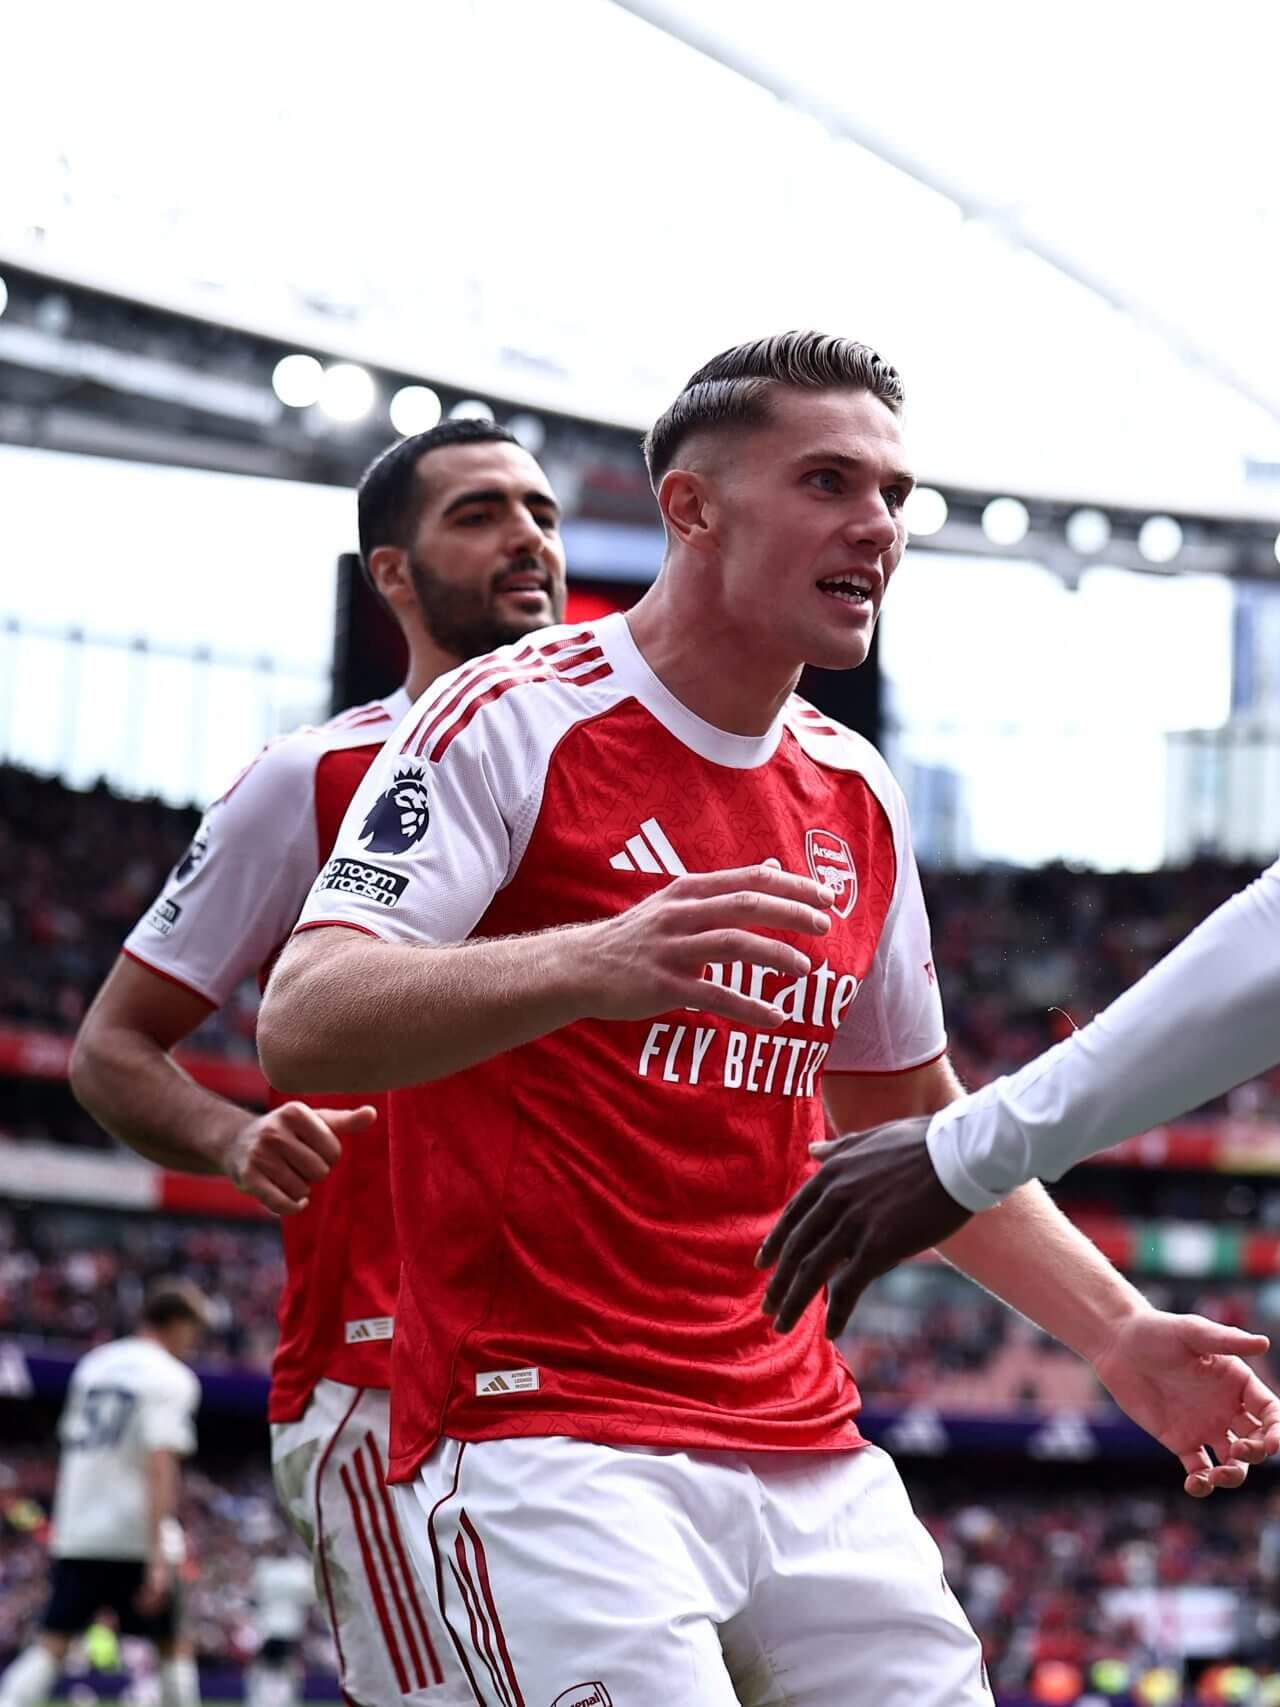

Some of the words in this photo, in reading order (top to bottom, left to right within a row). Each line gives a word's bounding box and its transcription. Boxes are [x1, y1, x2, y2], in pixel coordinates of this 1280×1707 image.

[330, 875, 397, 907] racism
[340, 863, 396, 891] room
[638, 1022, 716, 1085] FLY
[724, 1031, 829, 1097] BETTER
